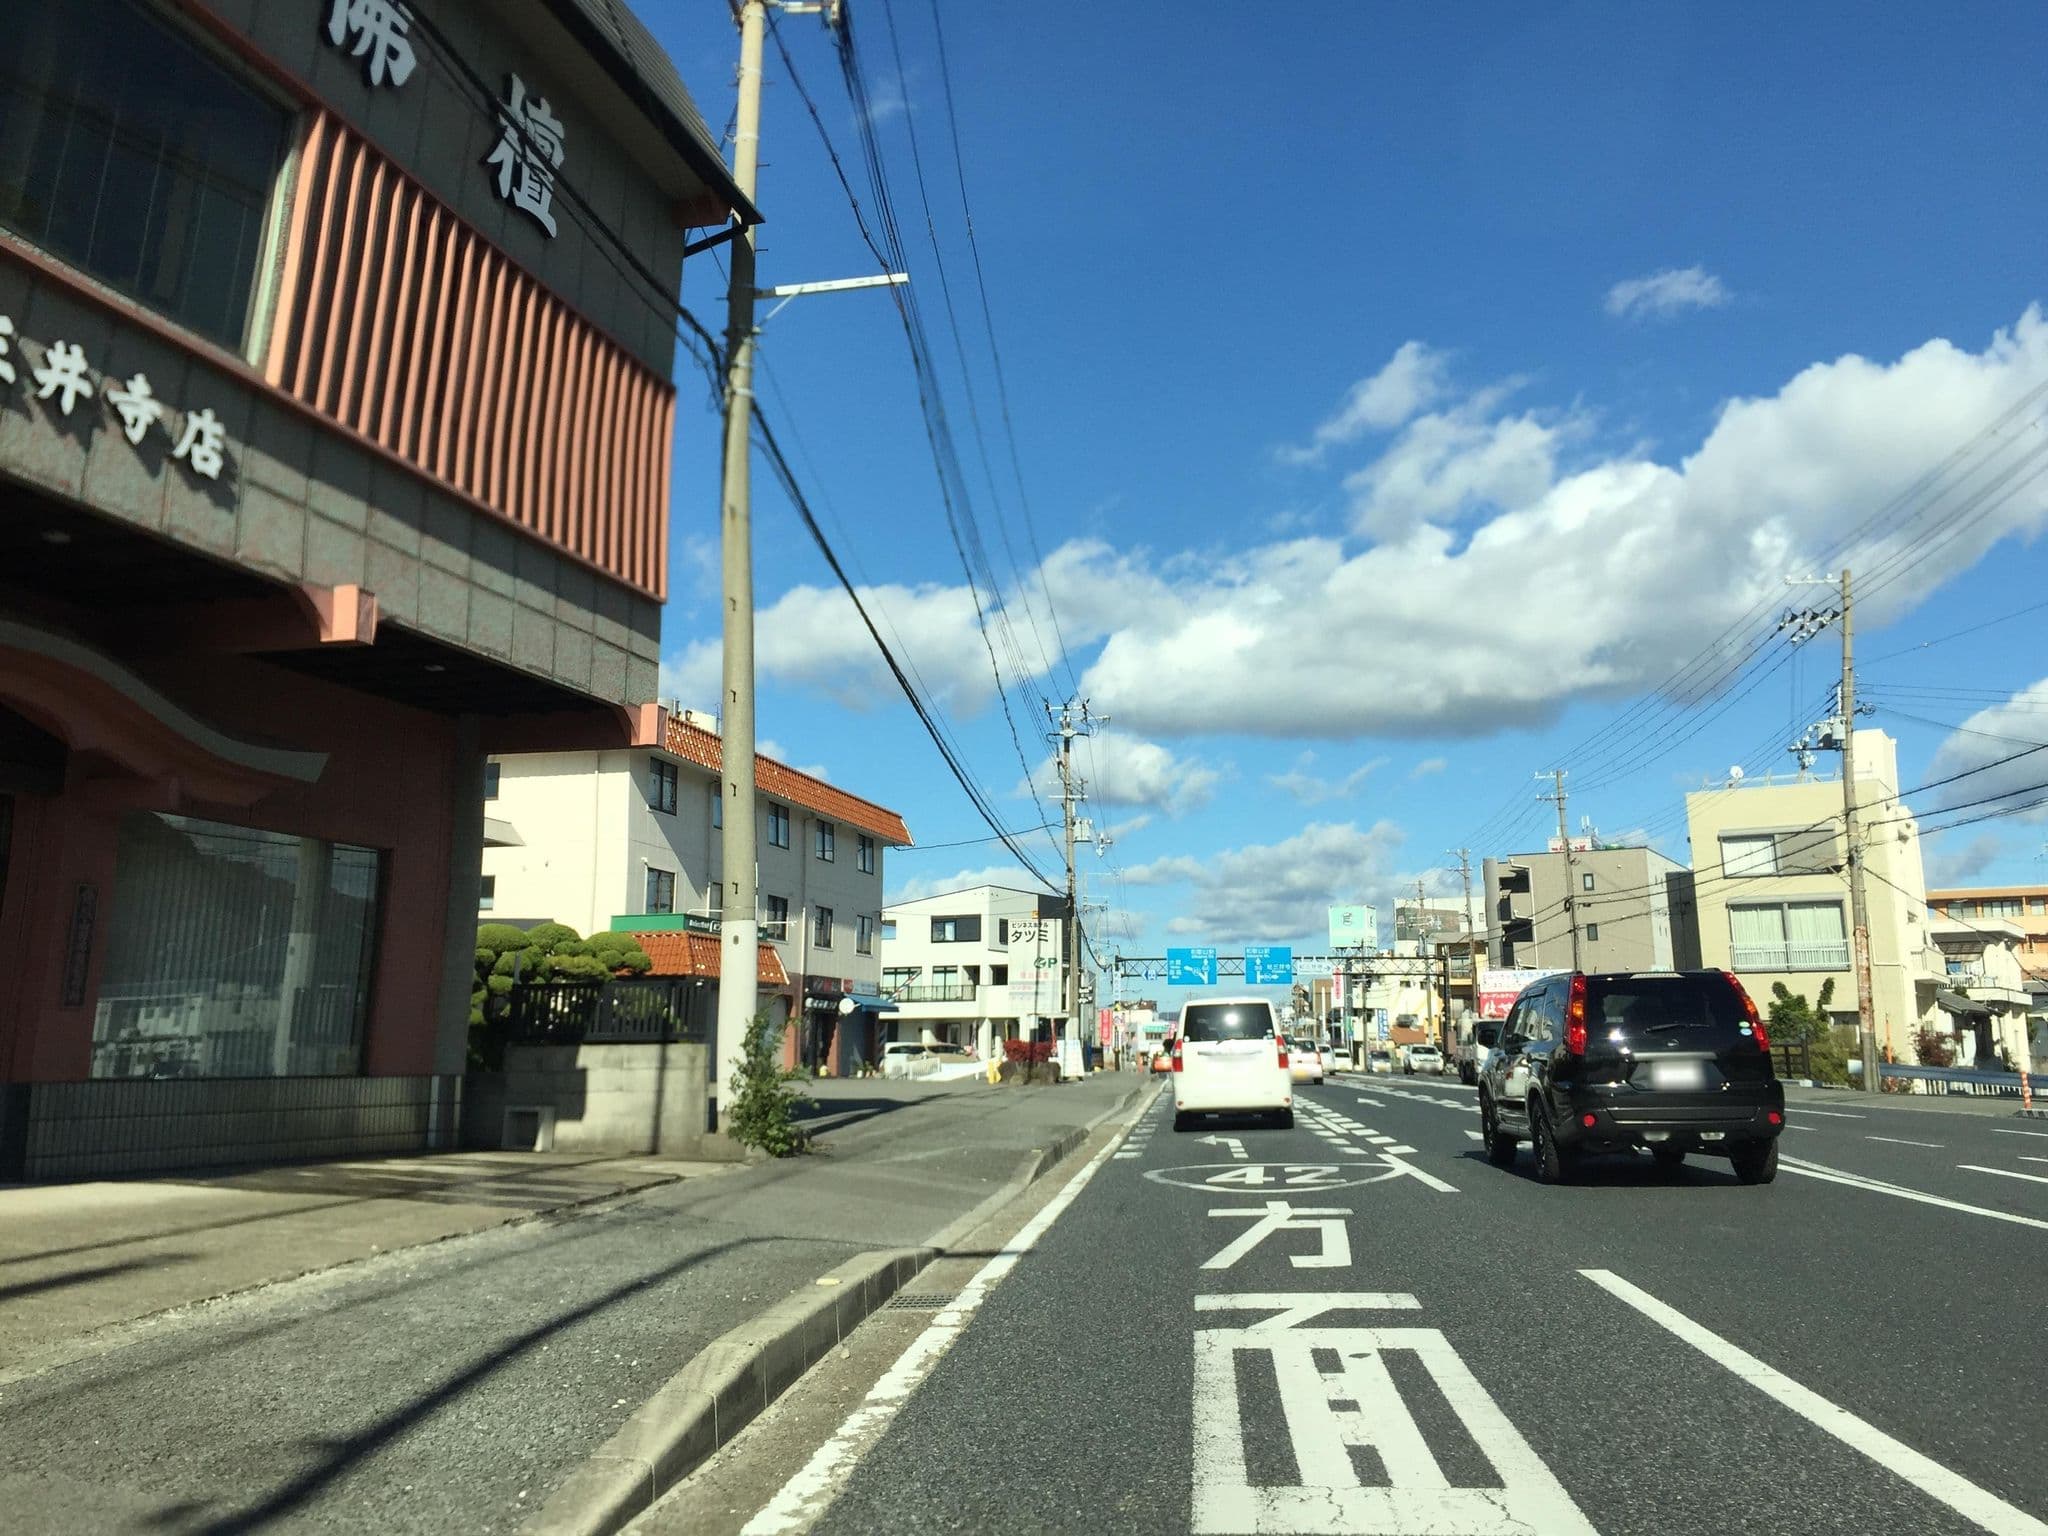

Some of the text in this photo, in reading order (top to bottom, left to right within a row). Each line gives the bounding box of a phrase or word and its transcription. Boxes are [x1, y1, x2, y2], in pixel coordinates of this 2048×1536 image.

[1011, 929, 1049, 943] タツミ
[1205, 1165, 1347, 1186] 42
